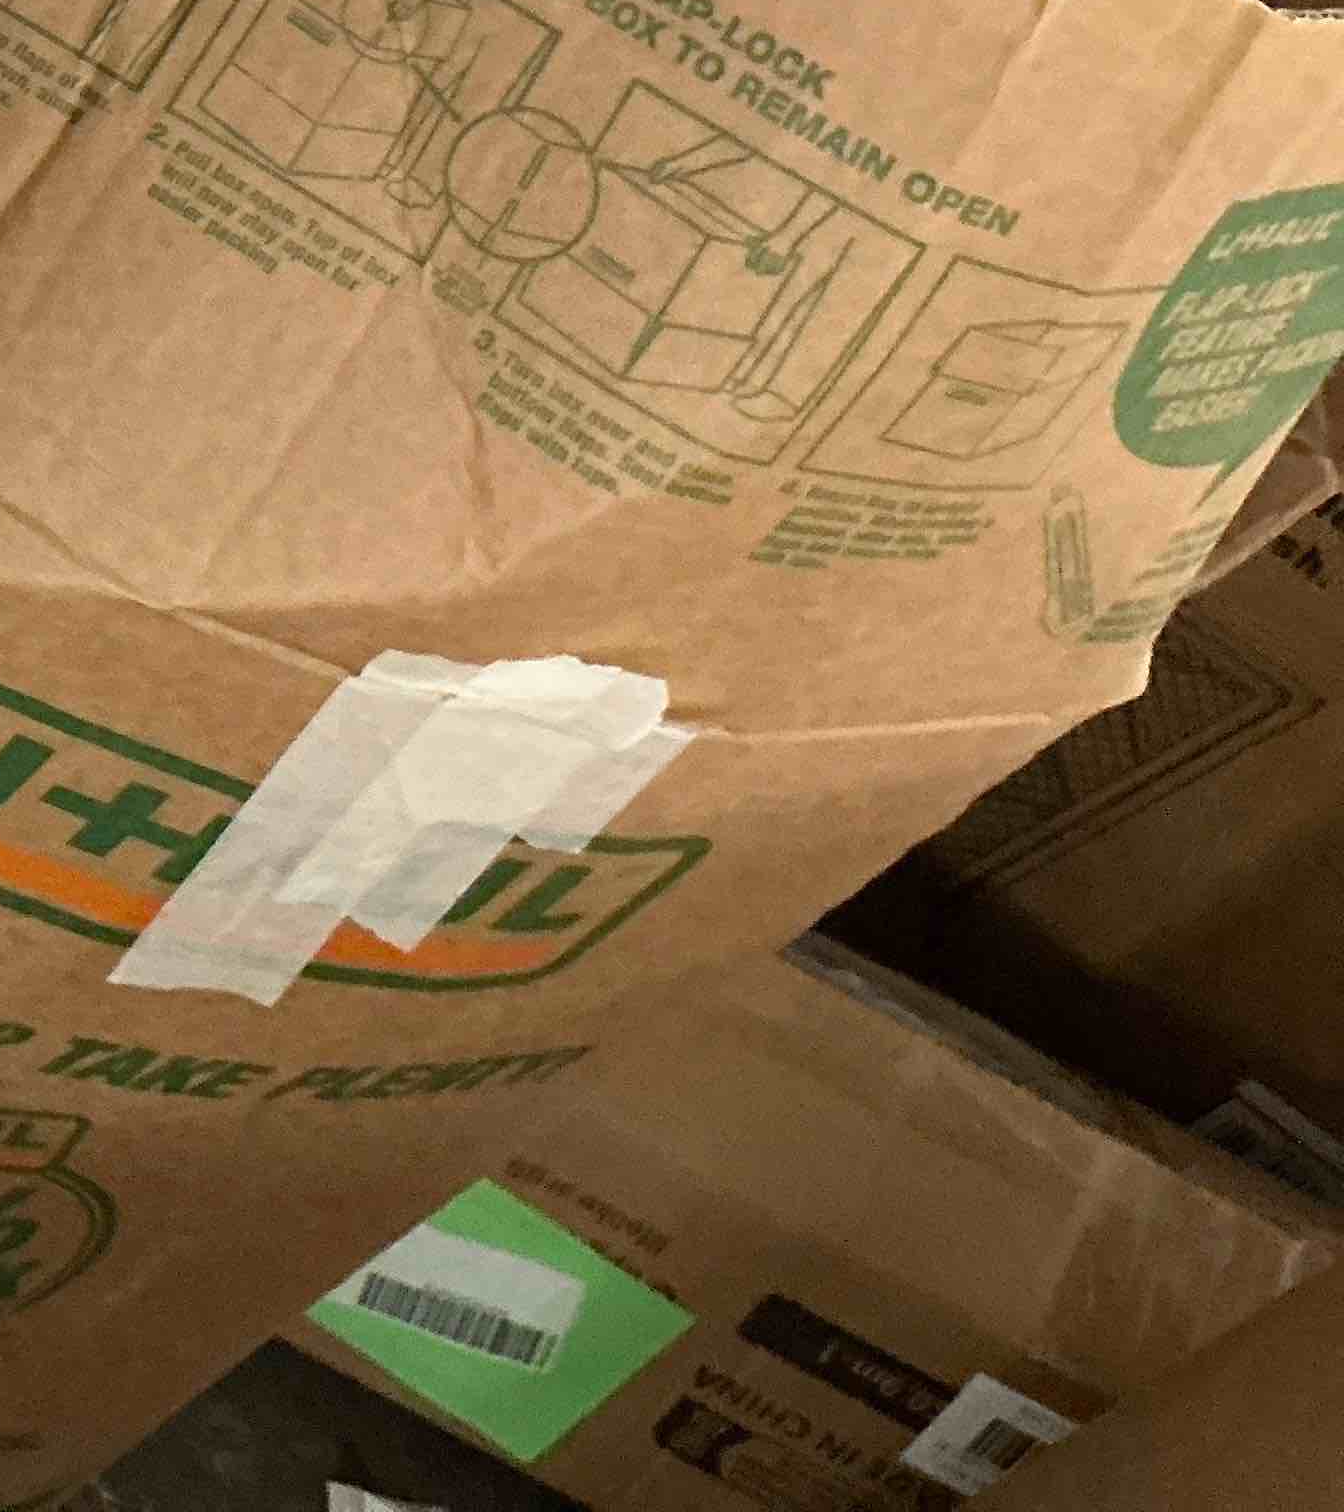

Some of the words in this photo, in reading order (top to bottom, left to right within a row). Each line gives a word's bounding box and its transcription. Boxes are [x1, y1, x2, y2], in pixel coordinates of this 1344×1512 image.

[664, 30, 732, 88] TO
[725, 68, 900, 186] REMAIN
[899, 168, 1023, 240] OPEN
[39, 1034, 278, 1100] TAKE
